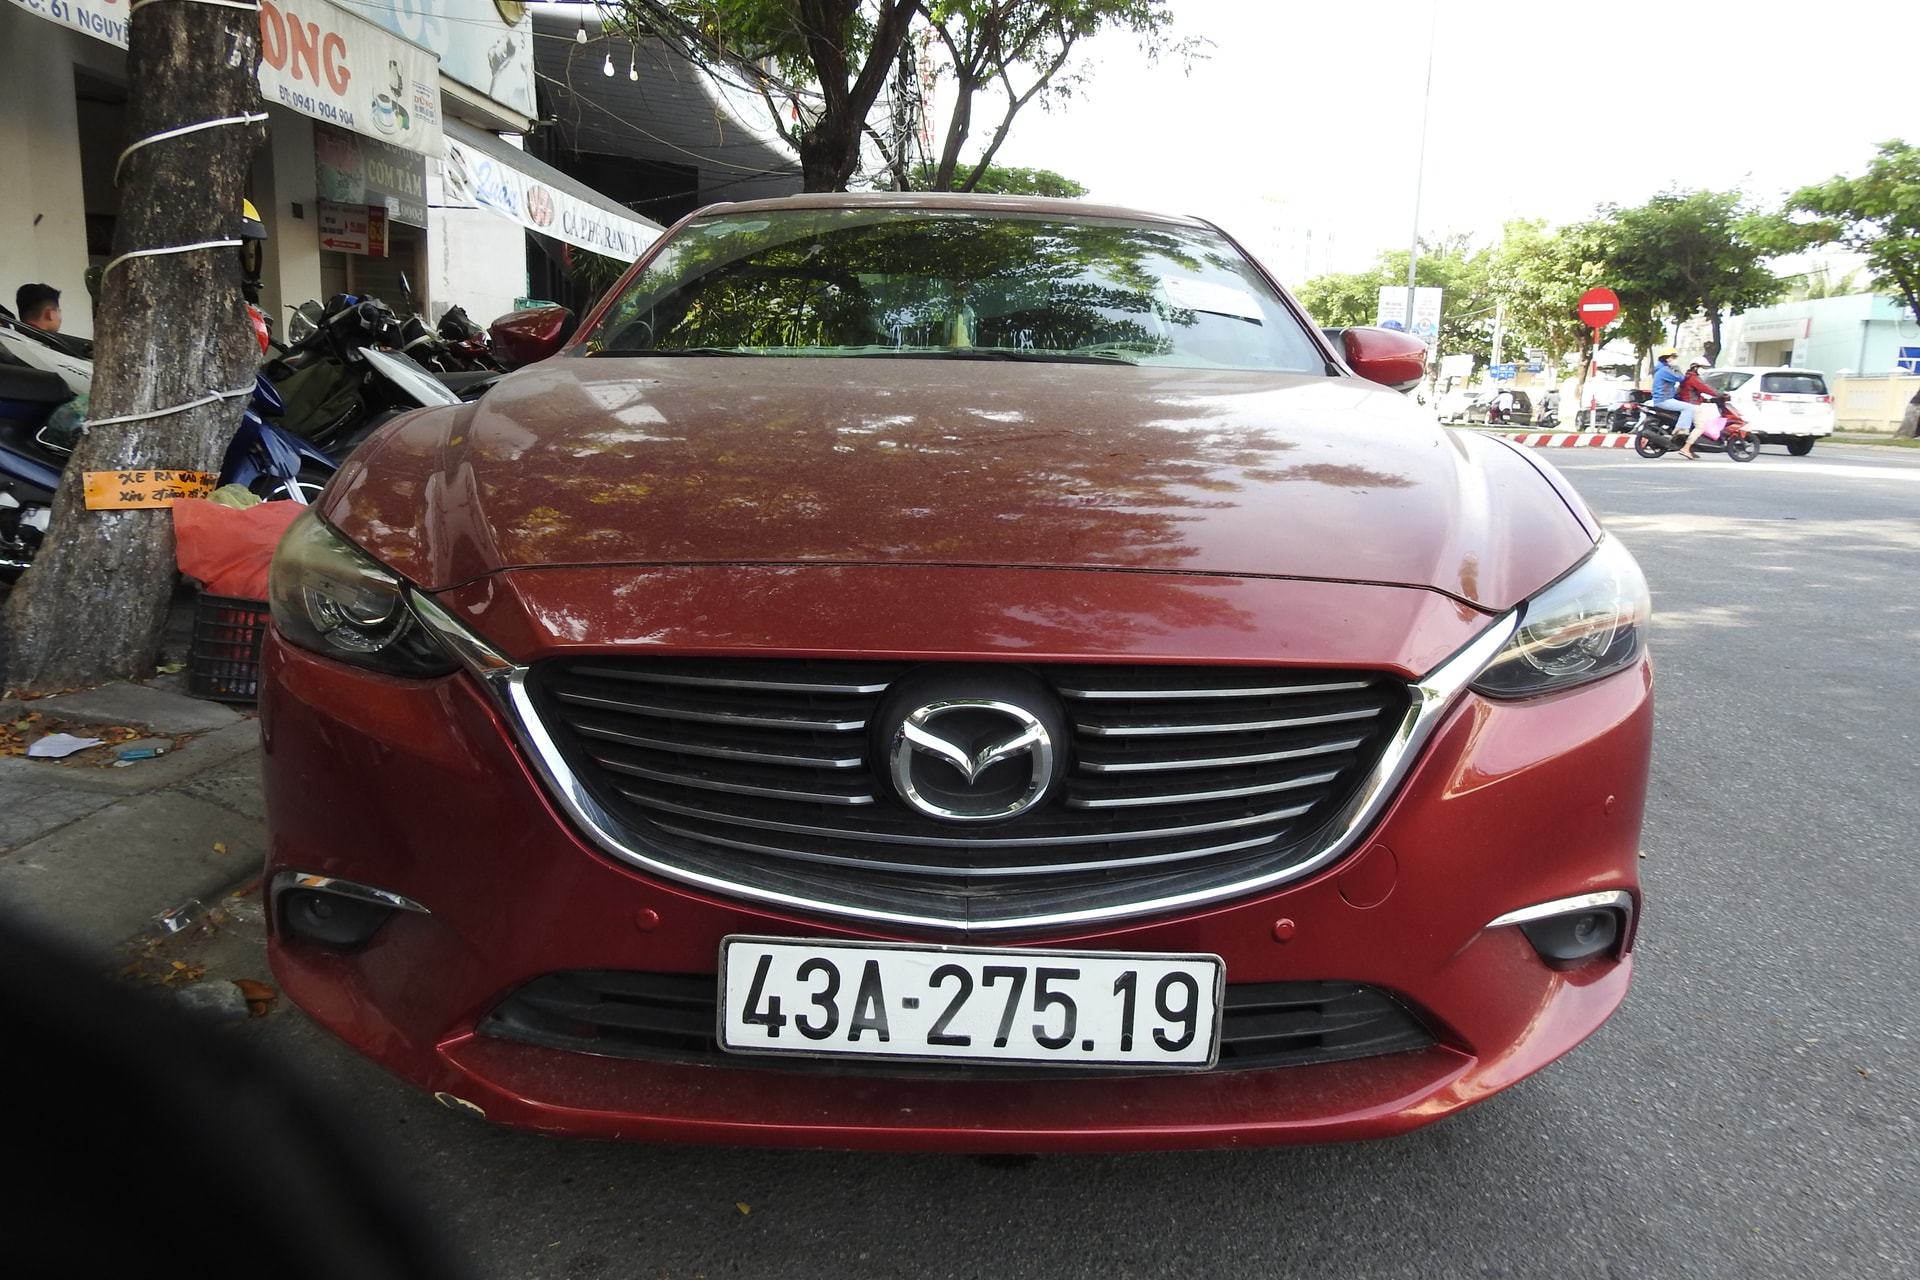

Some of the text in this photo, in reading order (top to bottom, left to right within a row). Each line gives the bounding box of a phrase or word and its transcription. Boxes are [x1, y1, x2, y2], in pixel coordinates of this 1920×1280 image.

[50, 0, 70, 22] 61
[293, 92, 315, 113] 0941
[319, 101, 337, 120] 904
[339, 109, 354, 127] 904
[367, 159, 394, 189] CƠM
[397, 161, 423, 198] TẤM
[369, 221, 384, 240] 63
[118, 472, 146, 485] XE
[742, 955, 1199, 1053] 43A-275.19
